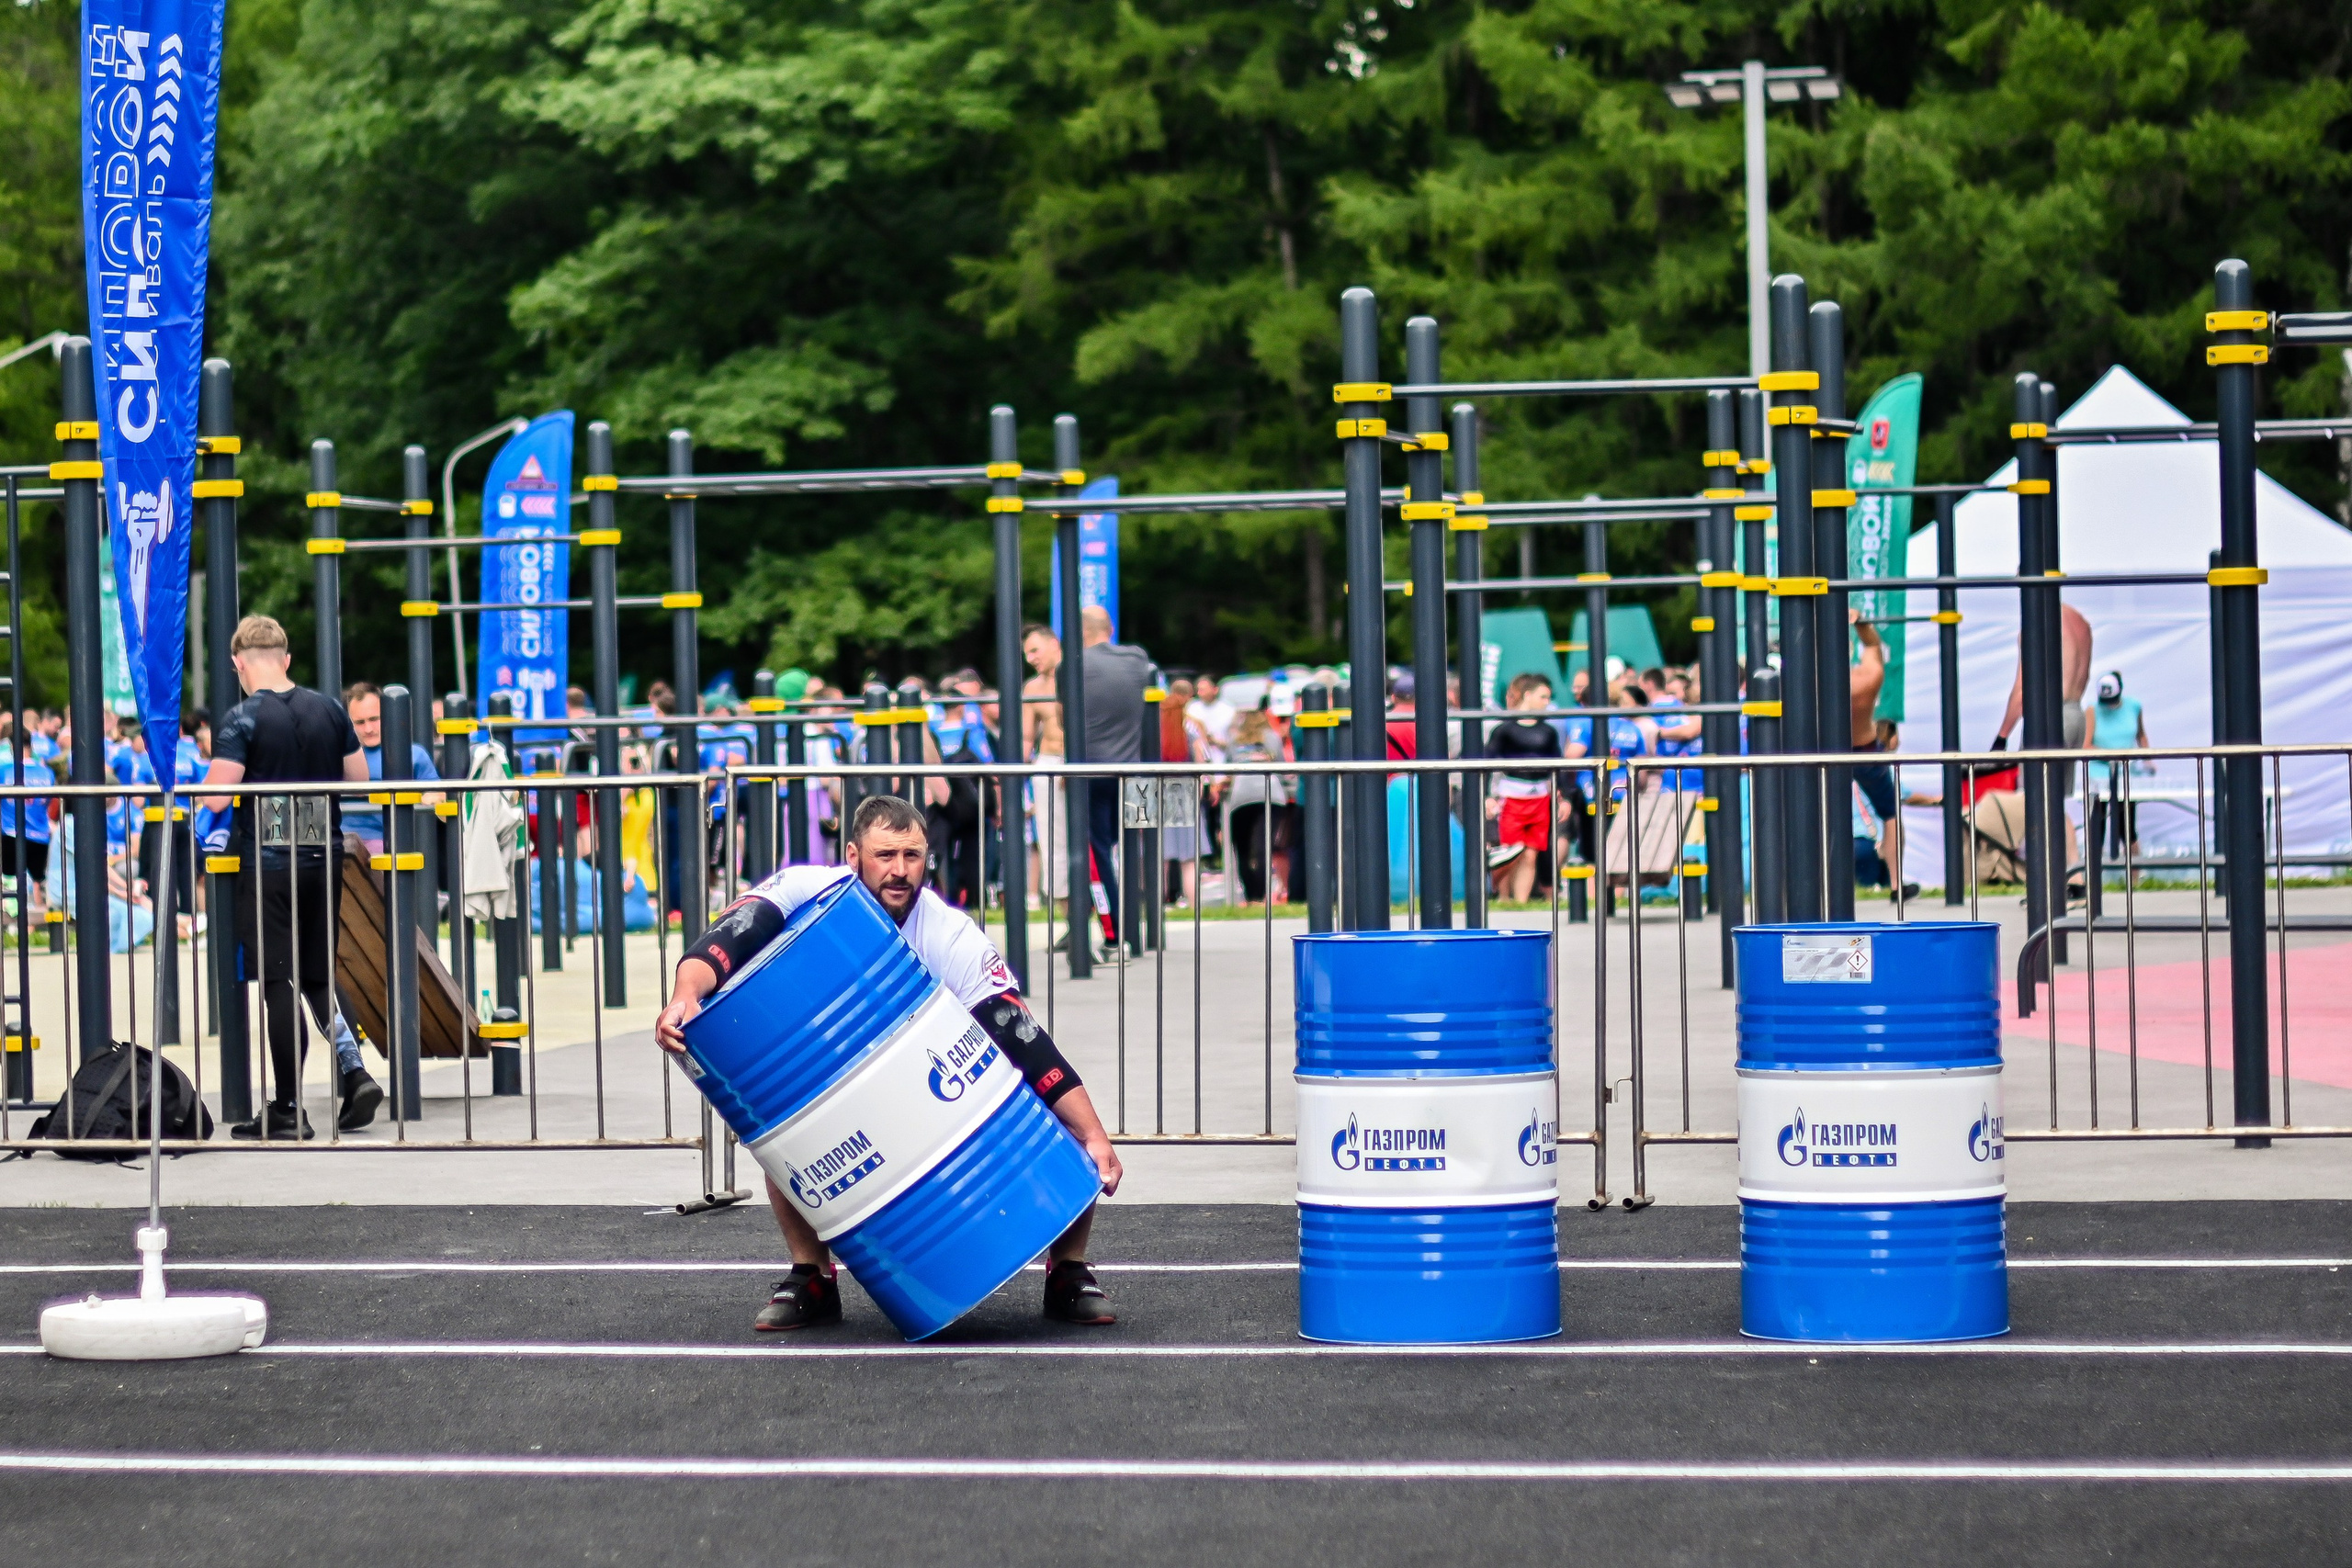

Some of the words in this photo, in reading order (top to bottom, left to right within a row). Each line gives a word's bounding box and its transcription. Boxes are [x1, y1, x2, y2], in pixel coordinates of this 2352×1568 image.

[1363, 1128, 1446, 1151] ГАЗПРОМ
[1811, 1123, 1897, 1146] ГАЗПРОМ
[803, 1129, 873, 1185] ГАЗПРОМ
[1366, 1158, 1444, 1170] НЕФТЬ
[1815, 1154, 1895, 1167] НЕФТЬ
[823, 1155, 883, 1200] НЕФТЬ
